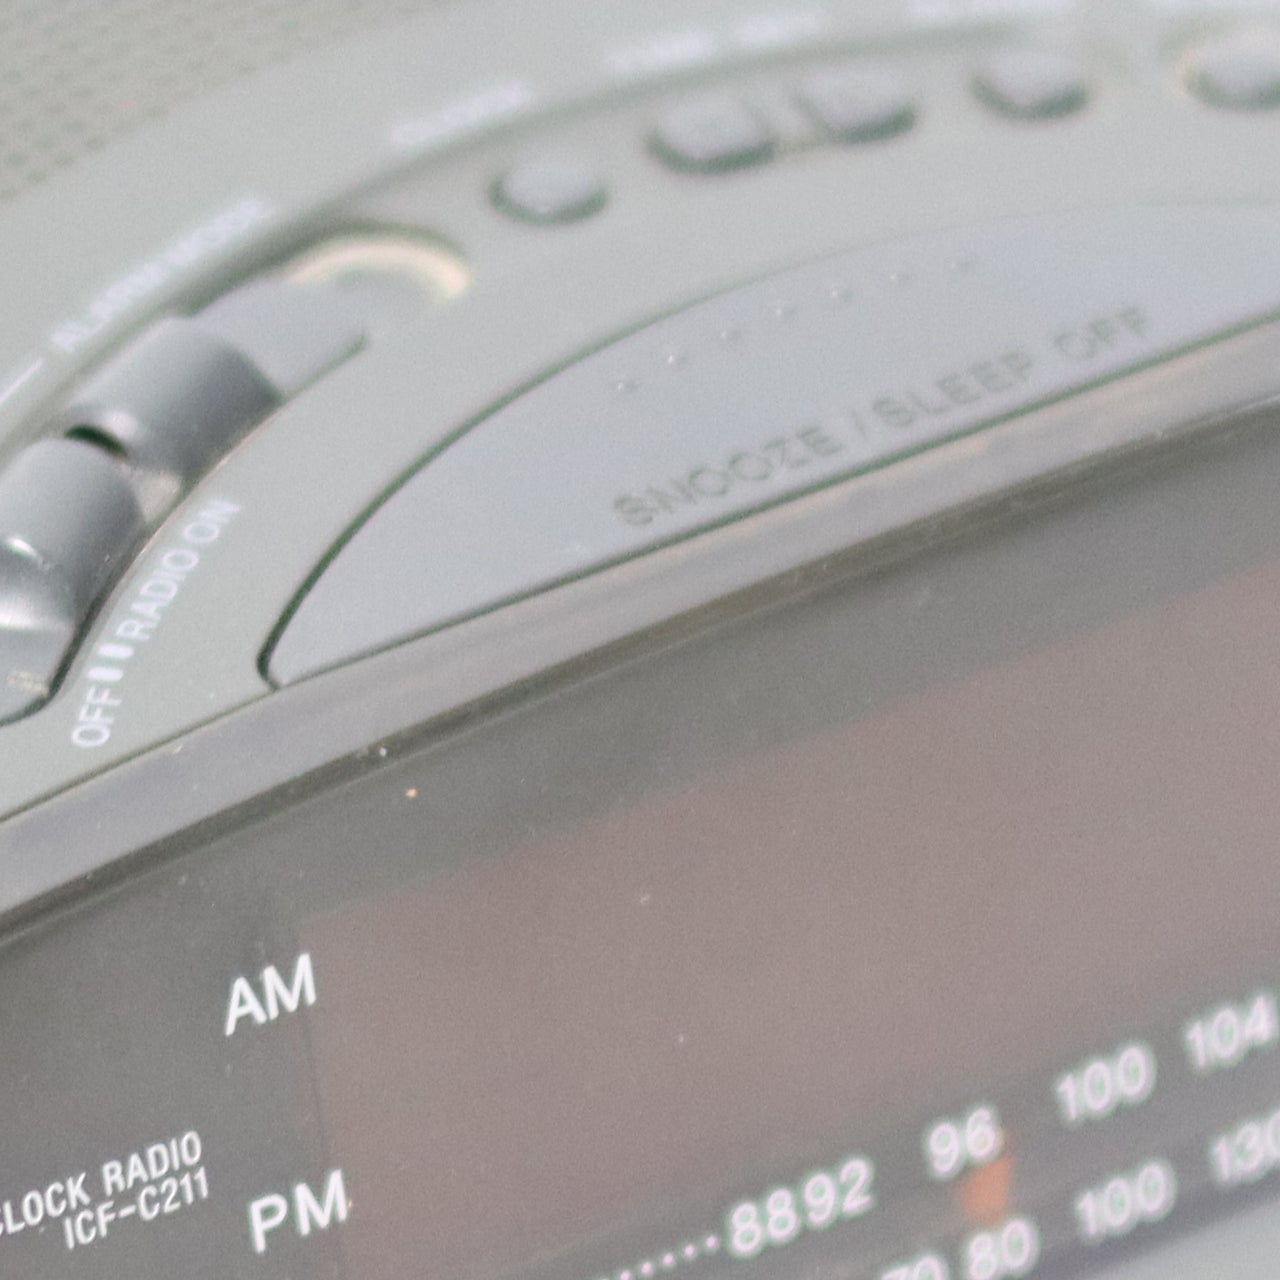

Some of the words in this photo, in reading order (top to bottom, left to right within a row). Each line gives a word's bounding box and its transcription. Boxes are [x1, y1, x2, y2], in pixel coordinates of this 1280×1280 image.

[613, 426, 843, 528] SNOOZE
[872, 350, 1034, 430] SLEEP
[1053, 303, 1148, 362] OFF
[71, 686, 123, 748] OFF
[117, 548, 200, 642] RADIO
[183, 495, 242, 546] ON
[223, 953, 317, 1037] AM
[927, 1106, 1001, 1179] 96
[1054, 1041, 1158, 1124] 100
[1182, 992, 1280, 1071] 104
[101, 1130, 202, 1196] RADIO
[1074, 1156, 1177, 1242] 100
[64, 1167, 209, 1249] ICF-C211
[247, 1168, 351, 1253] PM
